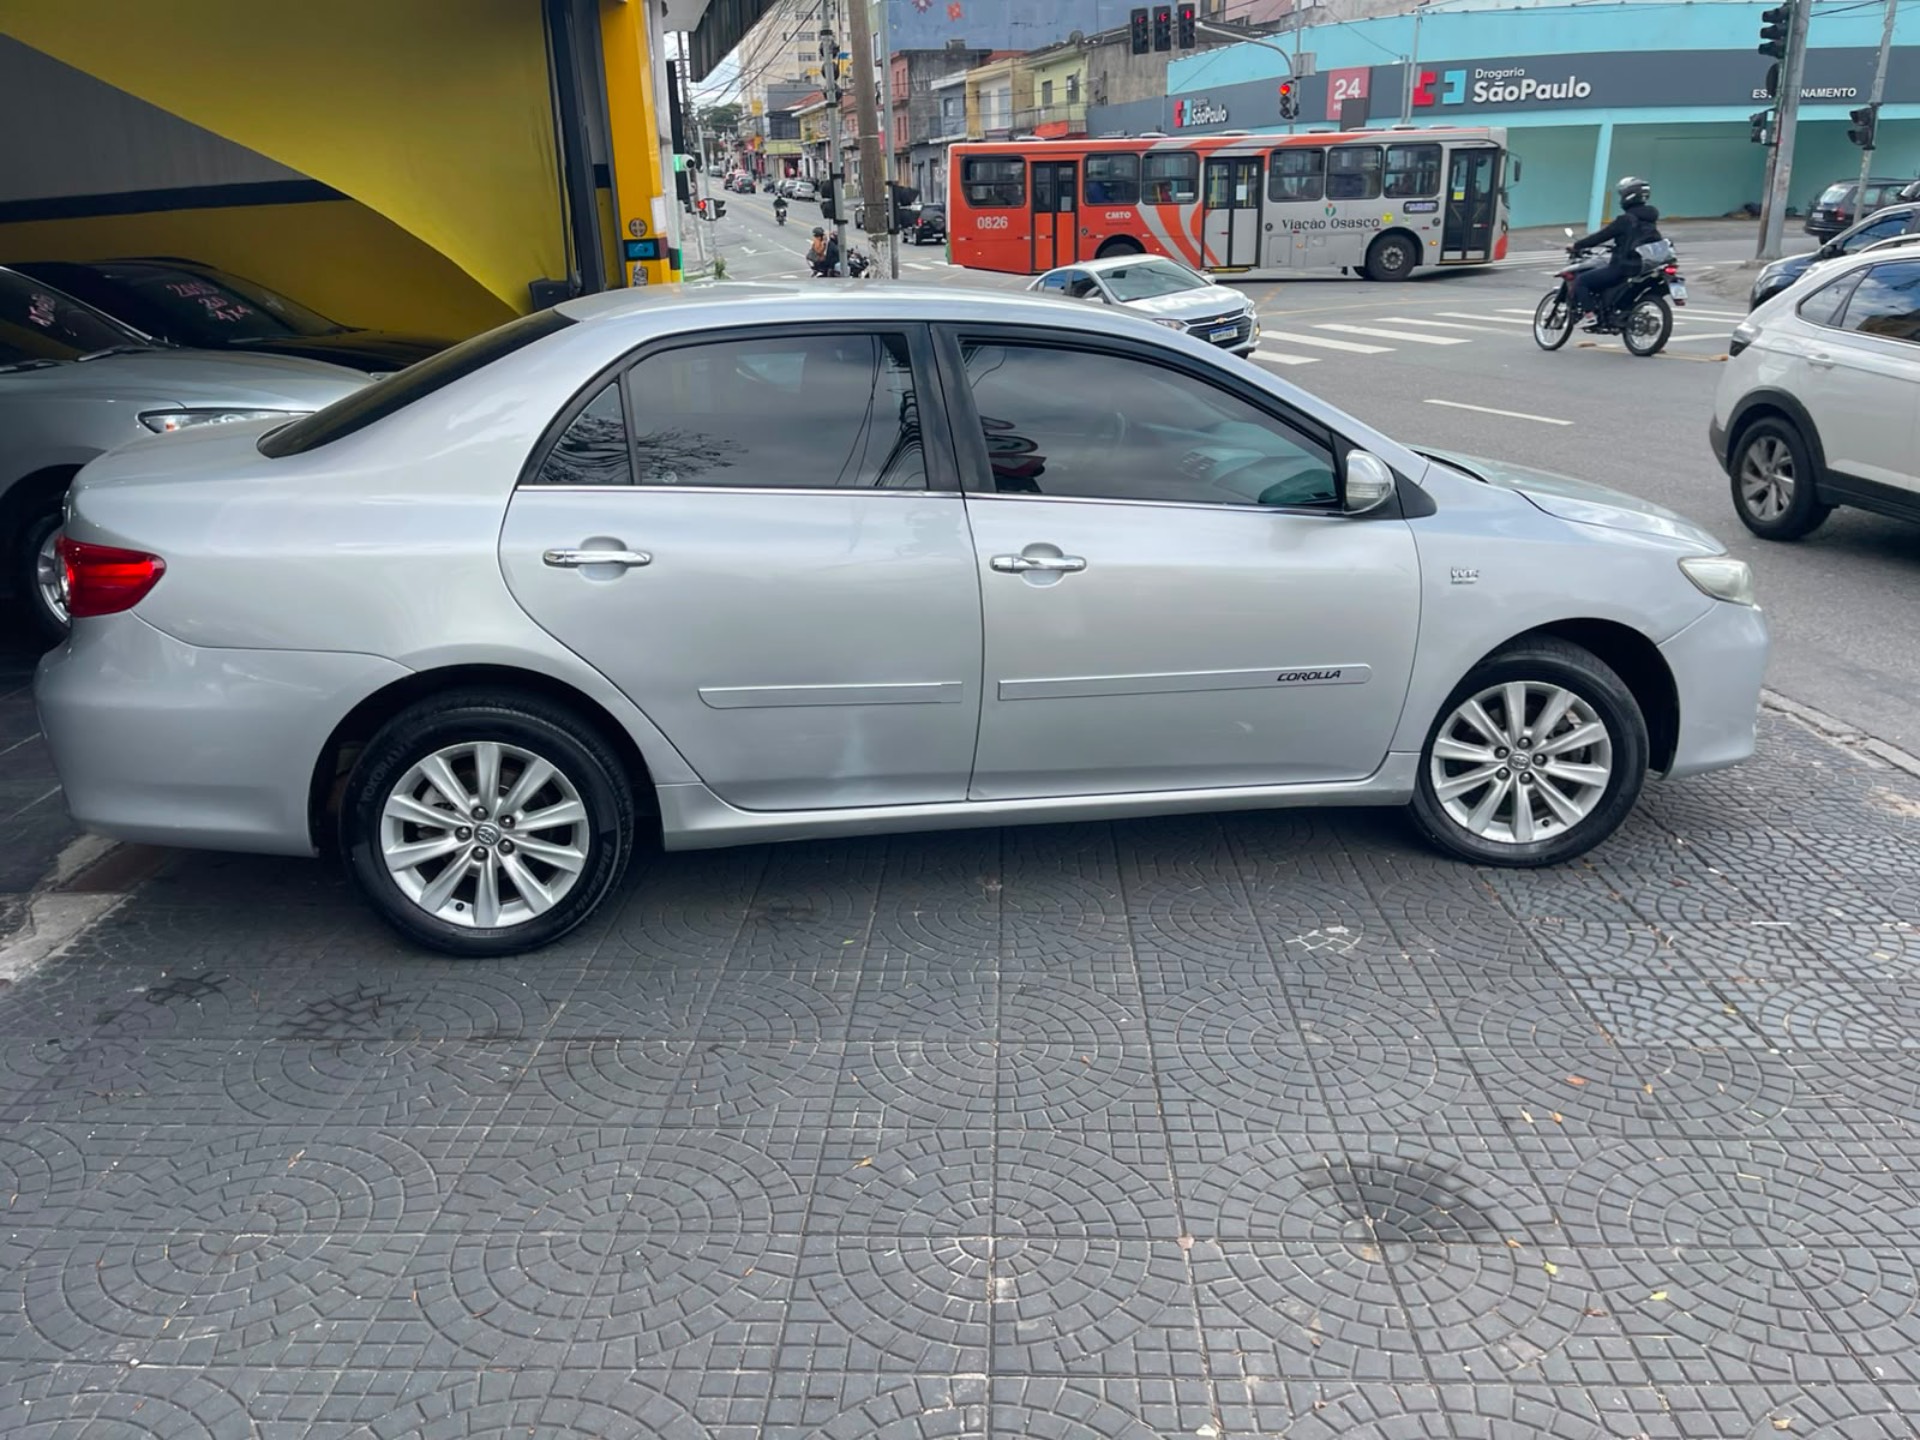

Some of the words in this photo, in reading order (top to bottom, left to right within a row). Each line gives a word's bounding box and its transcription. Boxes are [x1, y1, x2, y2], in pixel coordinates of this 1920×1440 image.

[1475, 67, 1525, 80] Drogaria
[1334, 77, 1361, 100] 24
[1473, 76, 1592, 103] SãoPaulo
[977, 215, 1008, 230] 0826
[1331, 216, 1381, 229] Osasco
[1276, 669, 1342, 682] COROLLA
